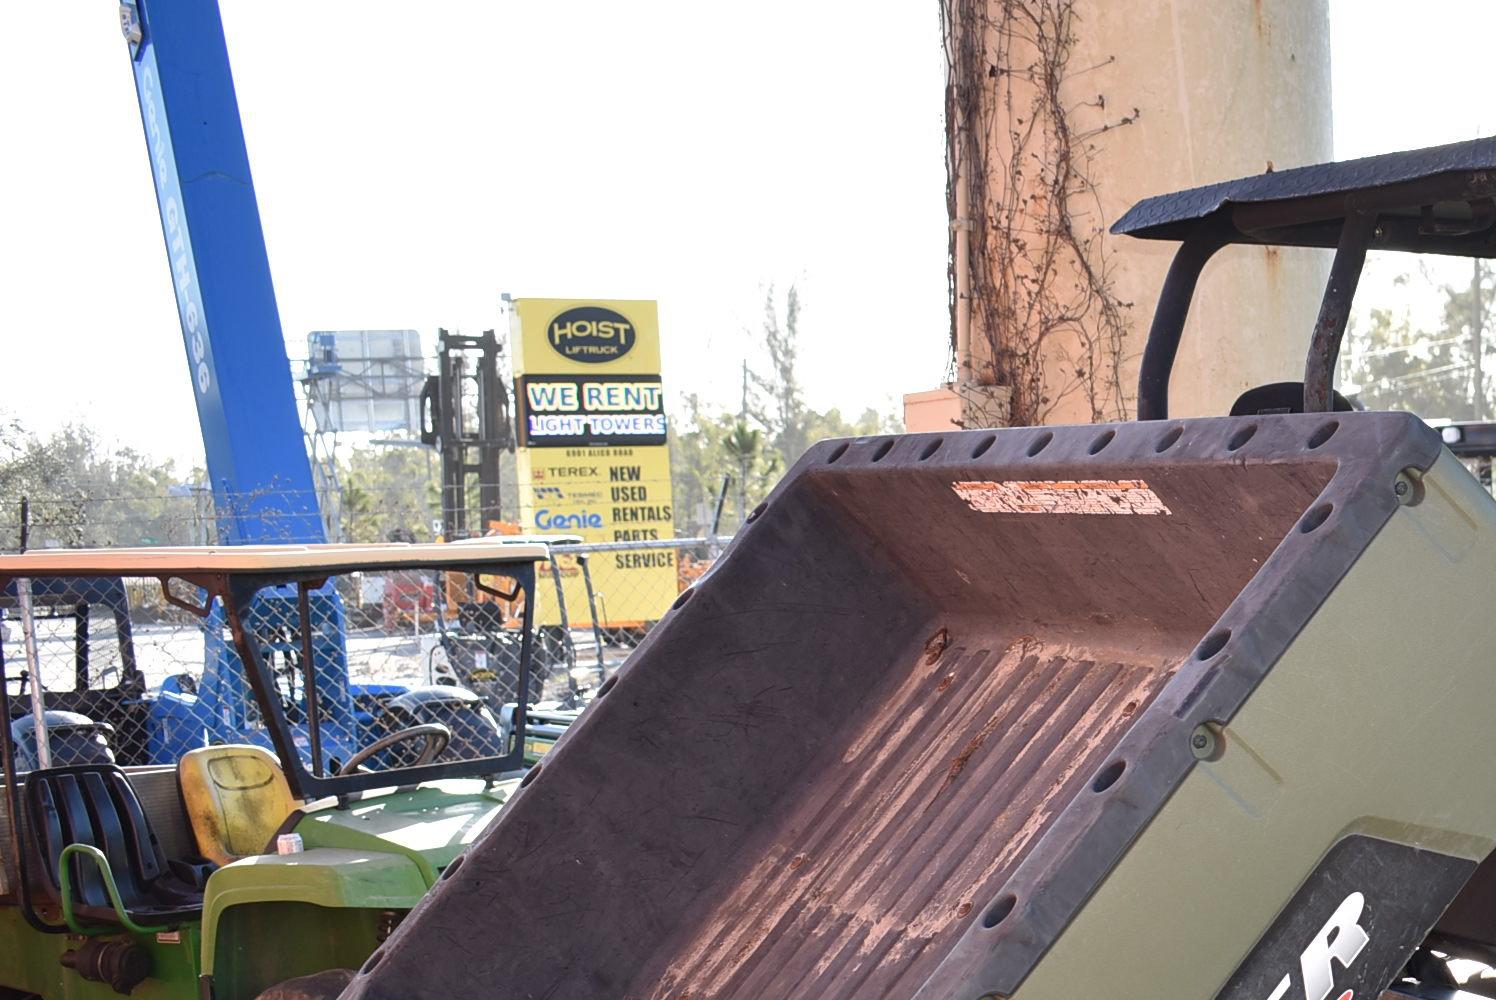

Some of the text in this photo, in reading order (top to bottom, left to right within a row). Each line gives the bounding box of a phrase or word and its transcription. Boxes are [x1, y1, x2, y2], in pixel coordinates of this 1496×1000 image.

[144, 66, 210, 394] Genie GTH-636
[553, 320, 630, 345] HOIST
[565, 345, 619, 354] LIFTRUCK
[529, 385, 661, 409] WE RENT
[529, 416, 667, 433] LIGHT TOWERS
[548, 467, 598, 477] TEREX
[609, 466, 641, 481] NEW
[610, 486, 647, 501] USED
[534, 509, 603, 530] Genie
[612, 506, 673, 522] RENTALS
[614, 528, 658, 542] PARTS
[616, 552, 674, 569] SERVICE
